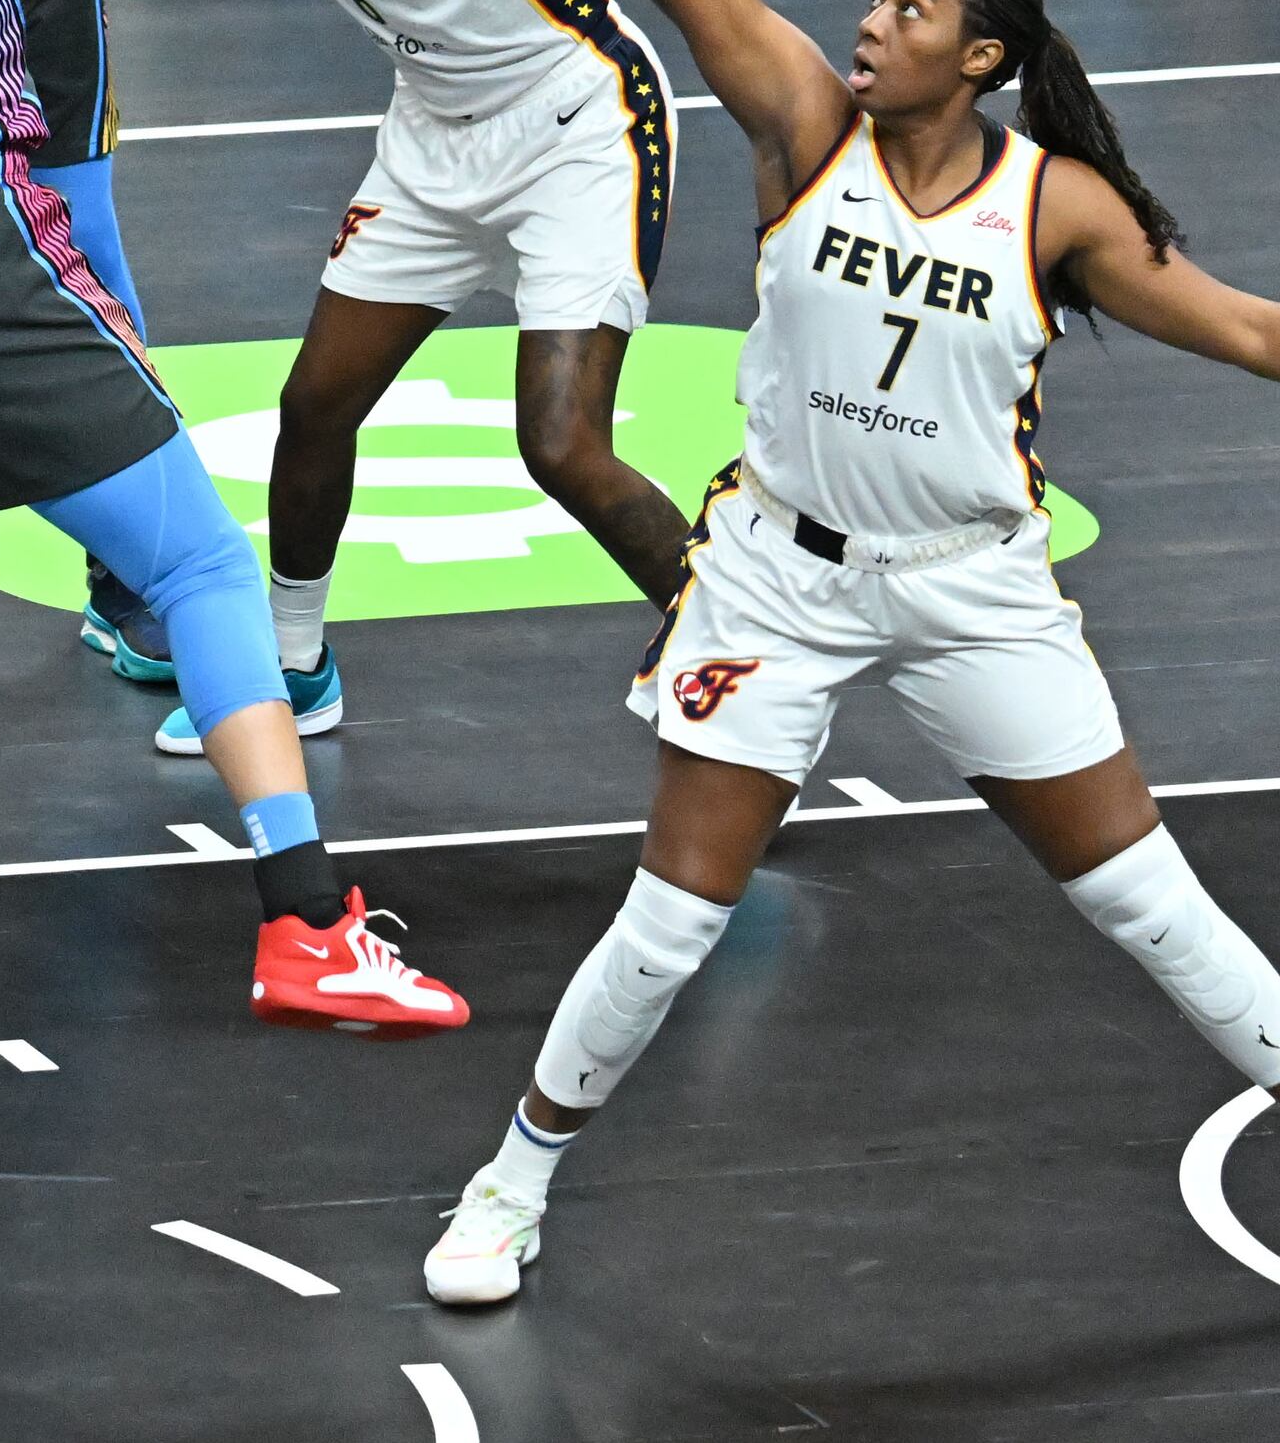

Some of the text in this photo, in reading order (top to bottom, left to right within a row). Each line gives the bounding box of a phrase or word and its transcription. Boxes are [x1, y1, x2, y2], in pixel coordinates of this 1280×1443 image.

[972, 210, 1016, 237] Lilly
[811, 223, 995, 322] FEVER
[876, 311, 920, 392] 7
[808, 390, 939, 439] salesforce
